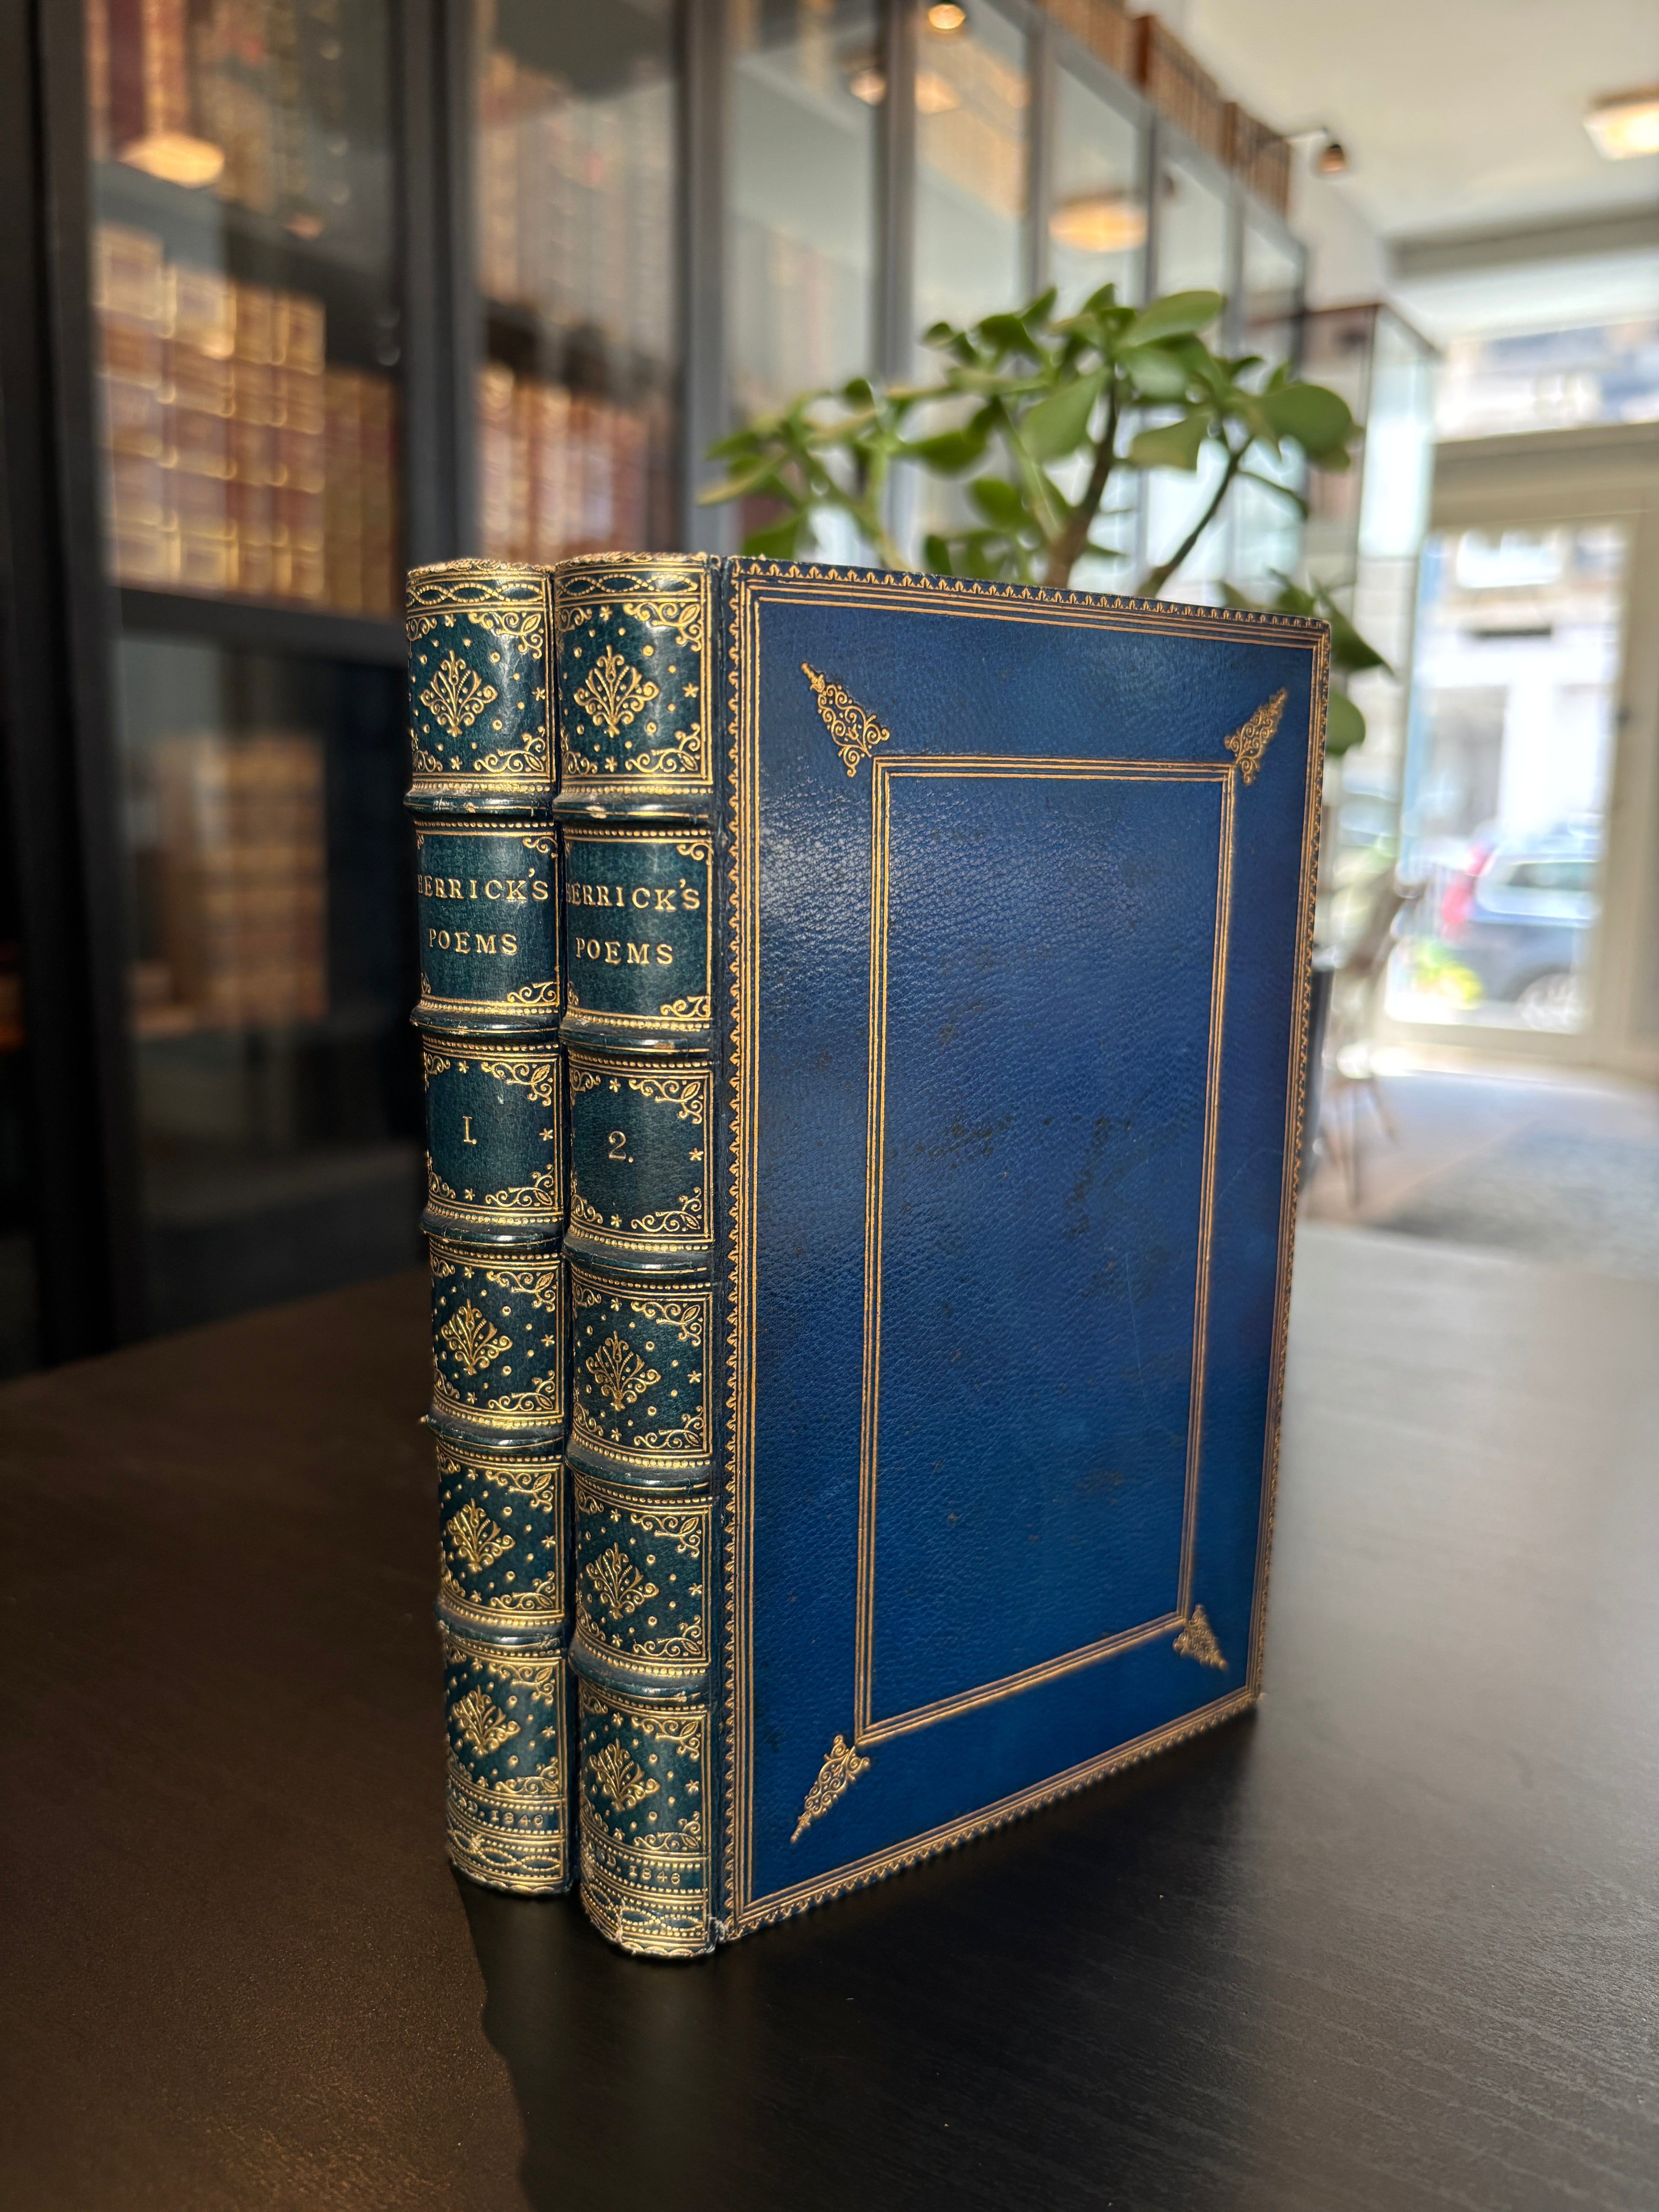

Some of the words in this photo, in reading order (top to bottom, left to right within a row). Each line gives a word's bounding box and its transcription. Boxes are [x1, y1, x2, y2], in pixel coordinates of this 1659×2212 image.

[417, 868, 548, 900] HERRICK'S
[429, 928, 517, 955] POEMS
[576, 937, 673, 965] POEMS
[609, 1131, 633, 1163] 2.
